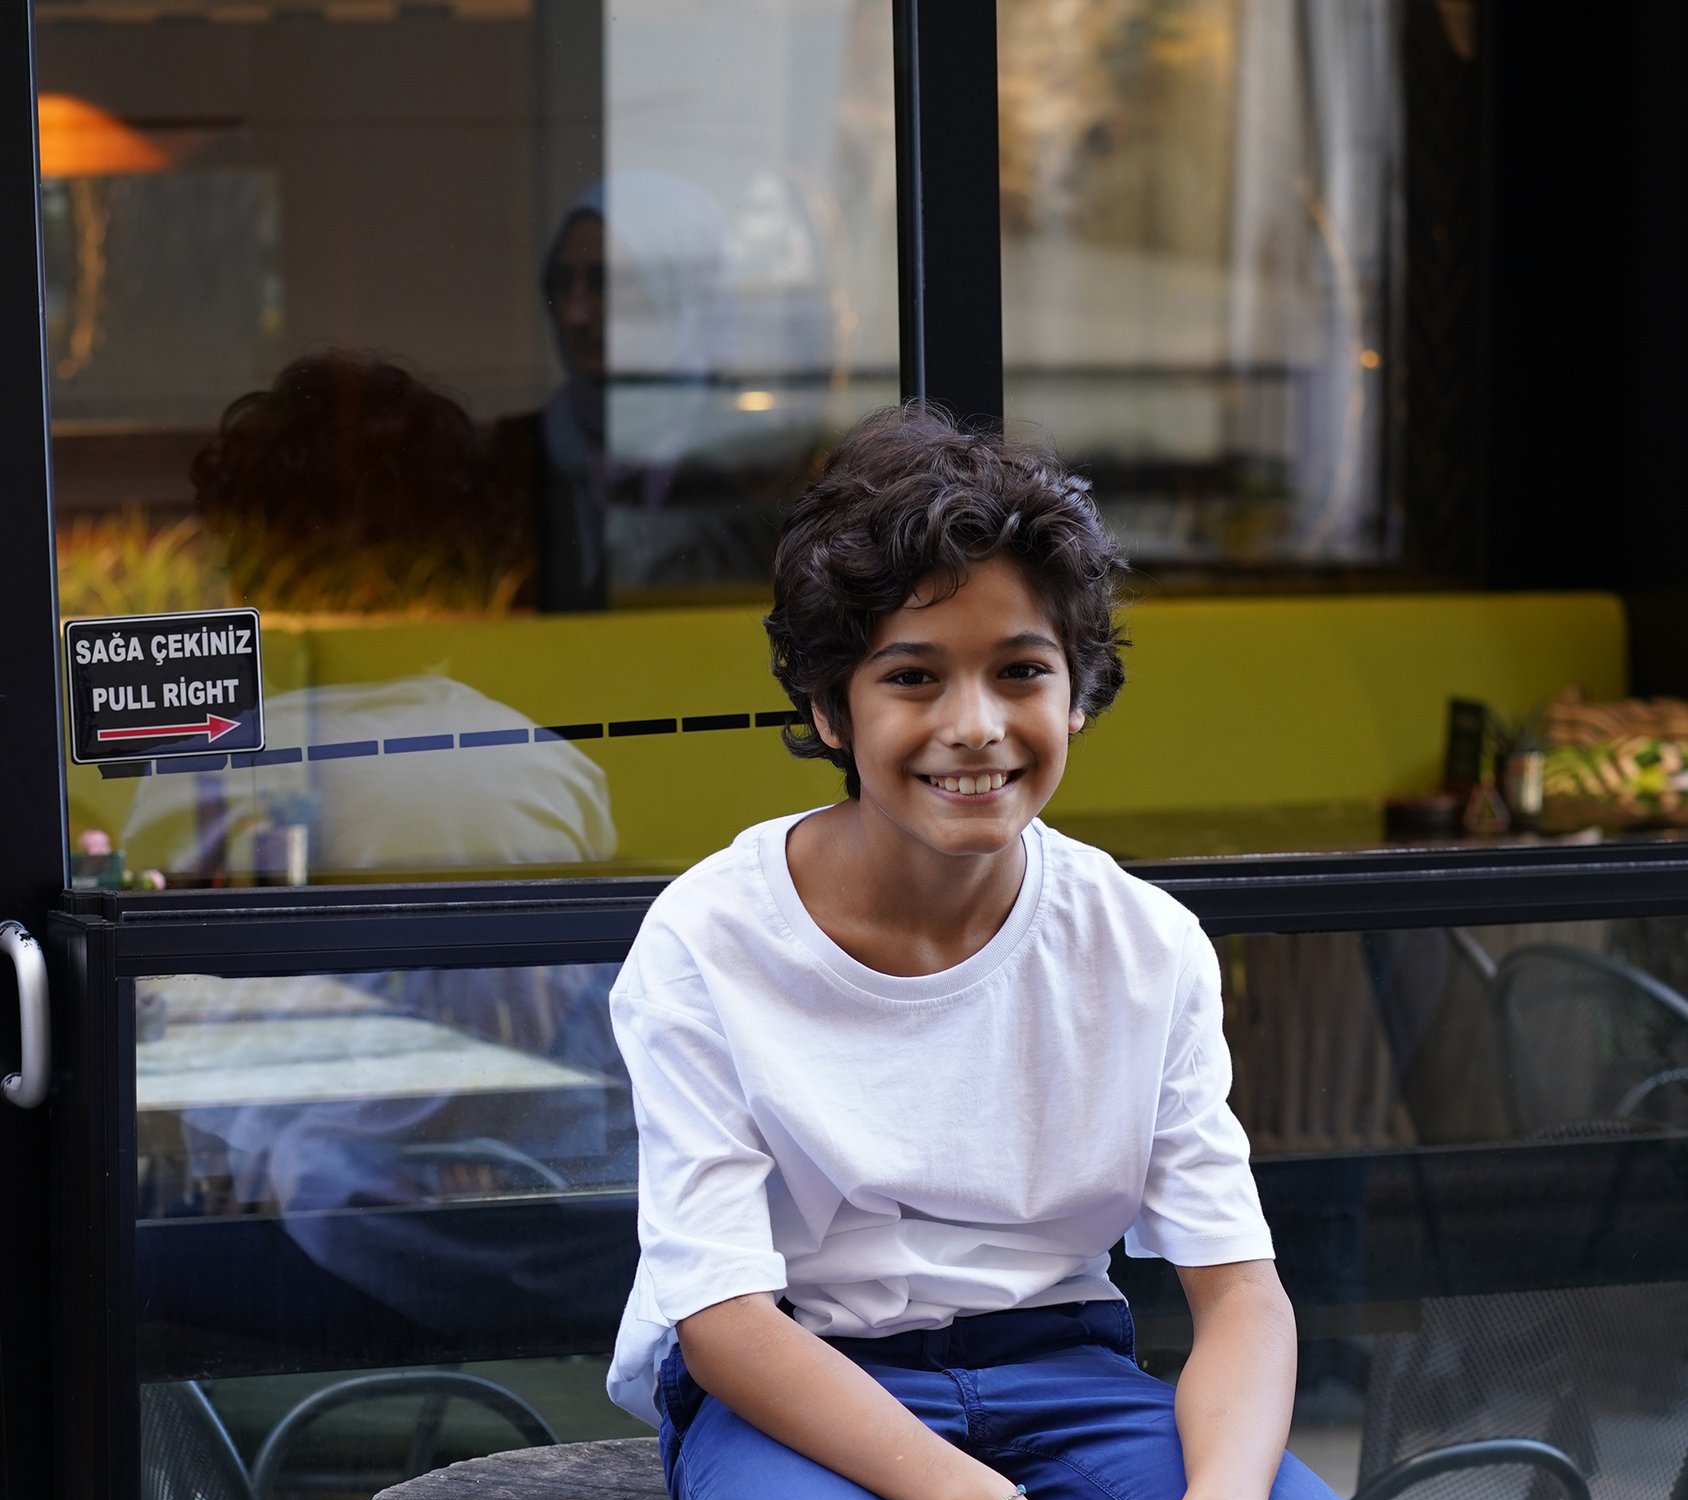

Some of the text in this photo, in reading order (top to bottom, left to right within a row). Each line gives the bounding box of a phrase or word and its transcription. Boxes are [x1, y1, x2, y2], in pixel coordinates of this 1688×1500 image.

[76, 625, 252, 665] SAĞA ÇEKİNİZ
[93, 685, 155, 712] PULL
